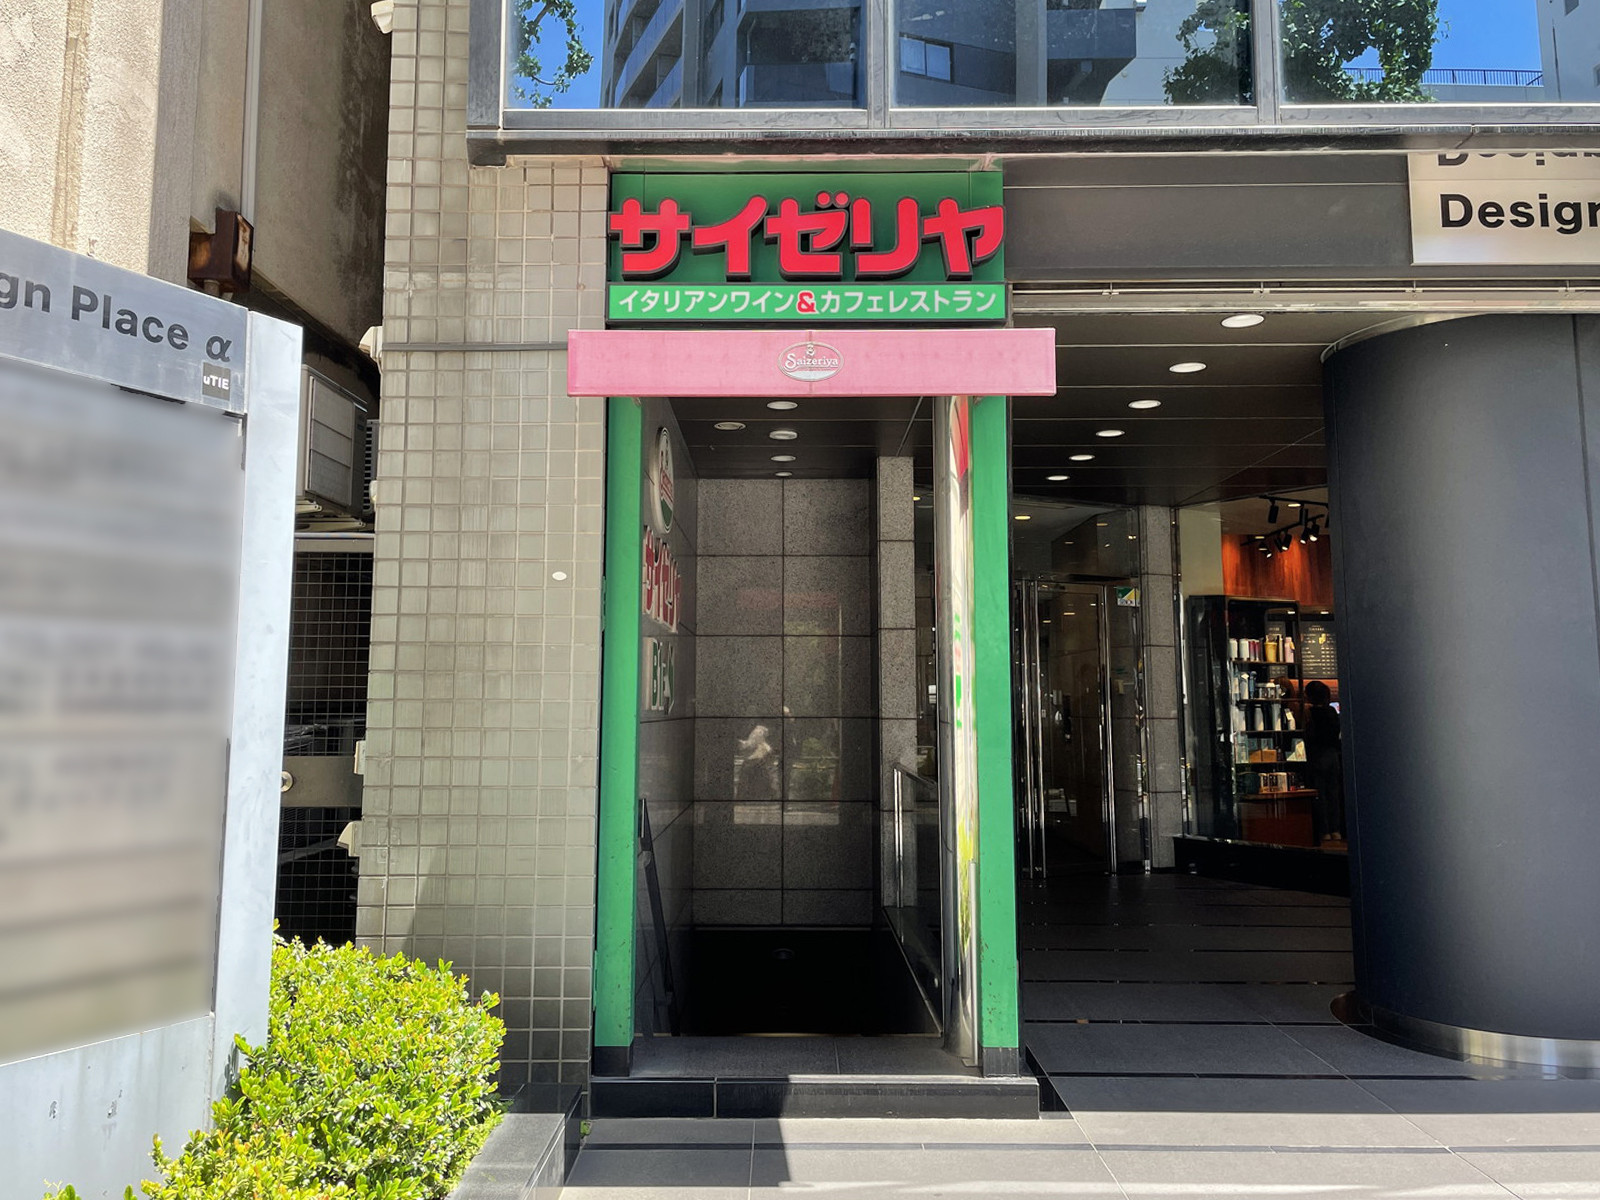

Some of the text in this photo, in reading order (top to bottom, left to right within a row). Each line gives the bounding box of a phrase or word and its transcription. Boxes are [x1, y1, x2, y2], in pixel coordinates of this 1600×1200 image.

[608, 190, 1006, 280] サイゼリヤ
[618, 289, 997, 315] イタリアンワイン&カフェレストラン
[71, 285, 190, 351] Place
[784, 353, 839, 370] Saizeriya
[203, 374, 230, 391] uTIE
